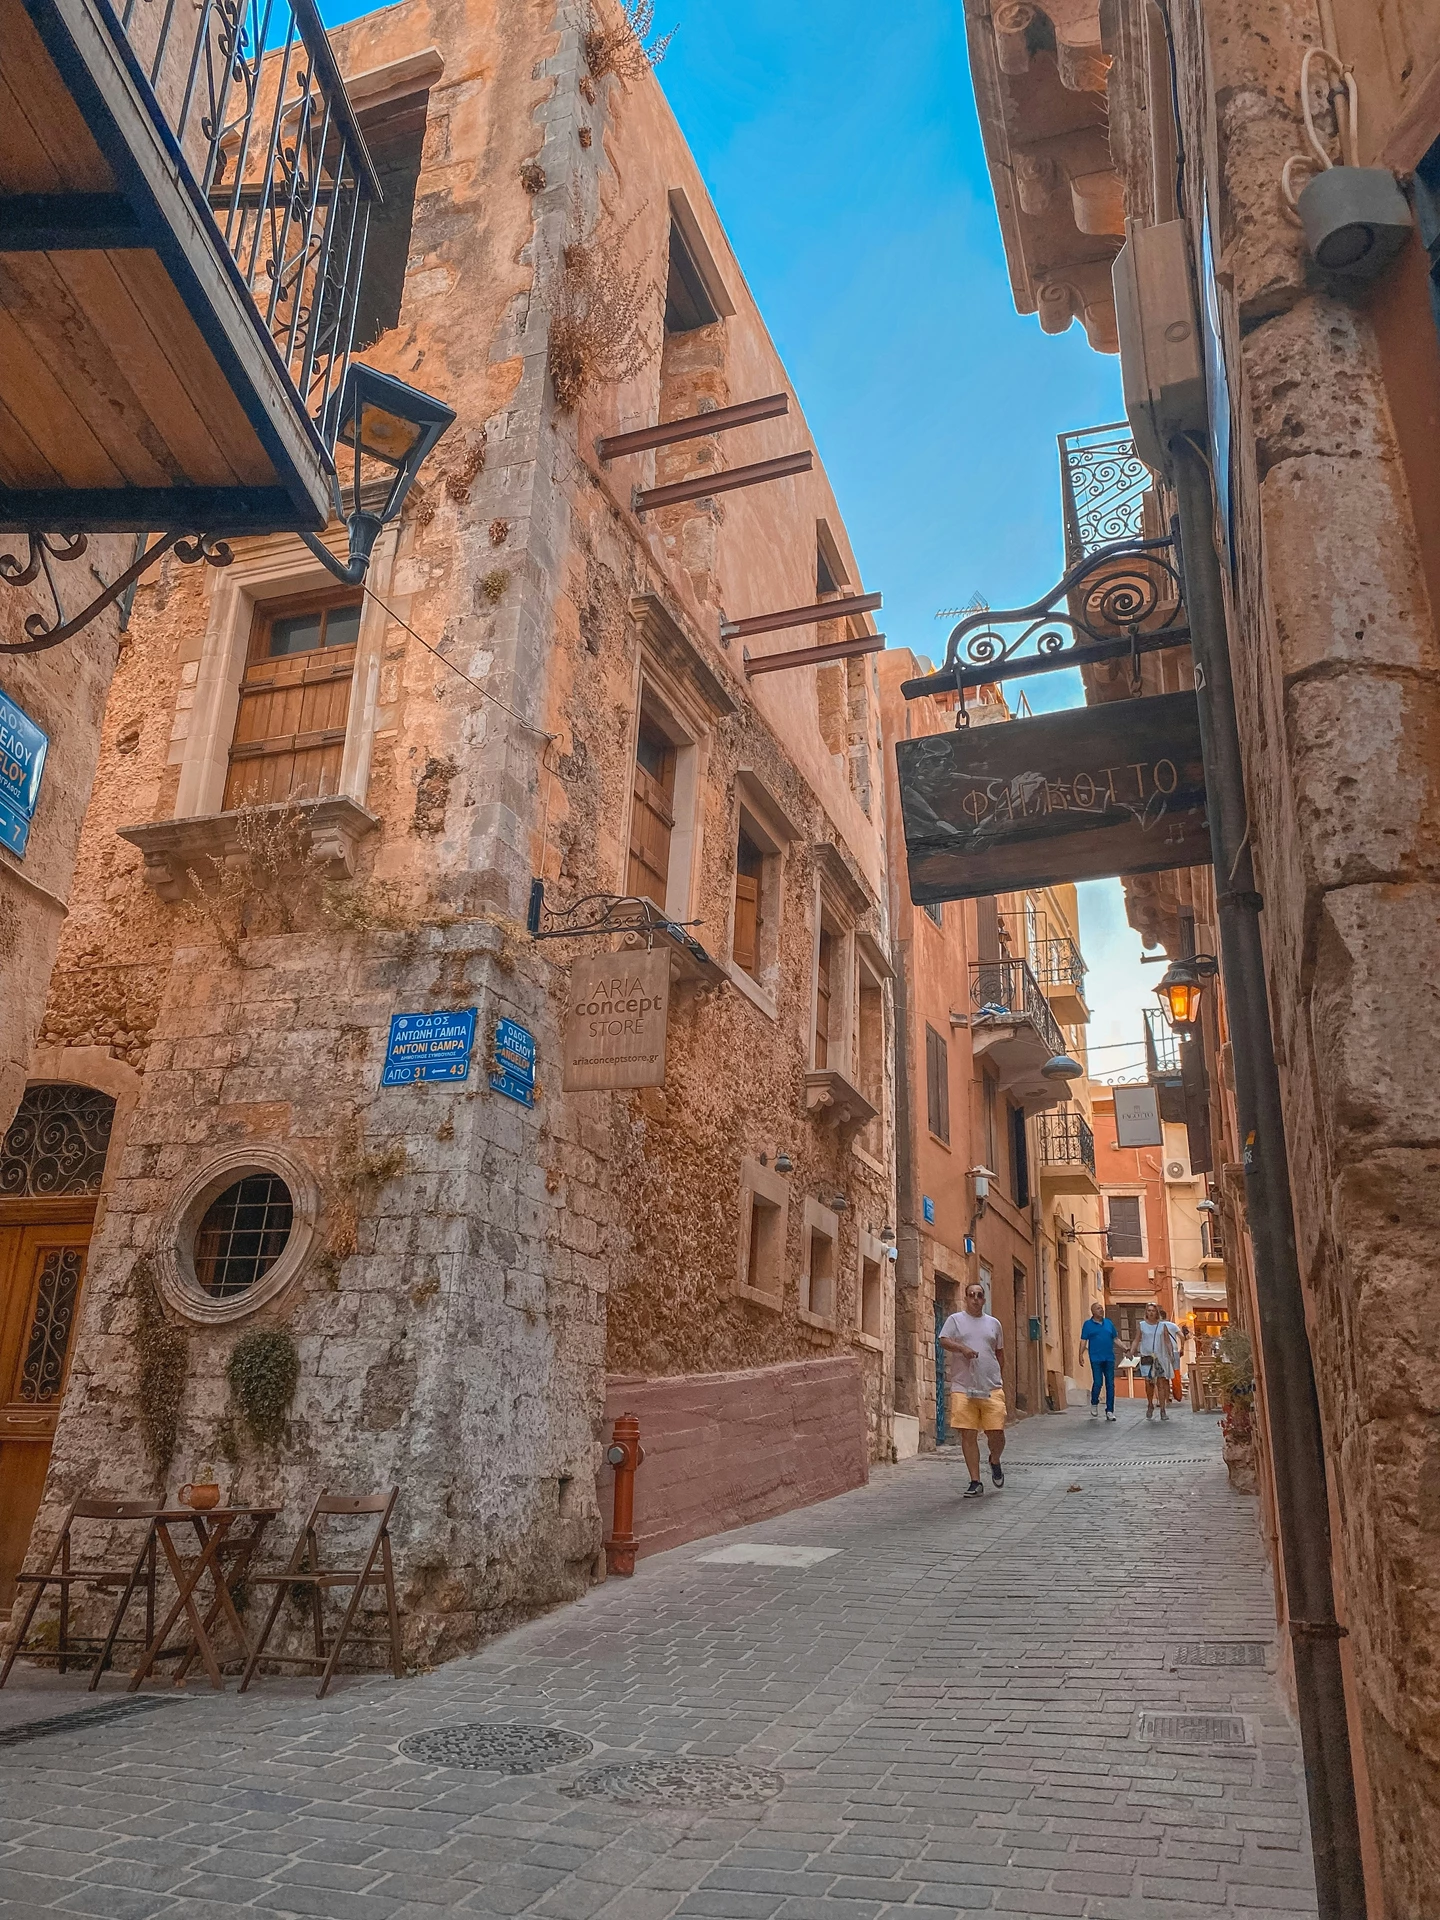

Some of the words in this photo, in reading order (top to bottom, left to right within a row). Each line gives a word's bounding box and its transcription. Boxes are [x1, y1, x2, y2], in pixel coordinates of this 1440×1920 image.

[0, 723, 32, 766] ΕΛΟΥ
[13, 824, 21, 842] 7
[591, 977, 646, 1000] ARIA
[575, 994, 662, 1018] concept
[416, 1016, 450, 1027] ΟΔΟΣ
[589, 1018, 645, 1038] STORE
[394, 1029, 433, 1042] ΑΝΤΩΝΗ
[434, 1026, 467, 1038] ΓΑΜΠΑ
[507, 1027, 527, 1044] ΟΔΟΣ
[392, 1042, 428, 1055] ANTONI
[430, 1040, 465, 1052] GAMPA
[503, 1035, 531, 1058] ΑΓΓΕΛΟΥ
[572, 1053, 659, 1066] ariaconceptstore.gr
[387, 1068, 411, 1080] ΑΠΟ
[413, 1066, 426, 1078] 31
[449, 1064, 465, 1075] 43
